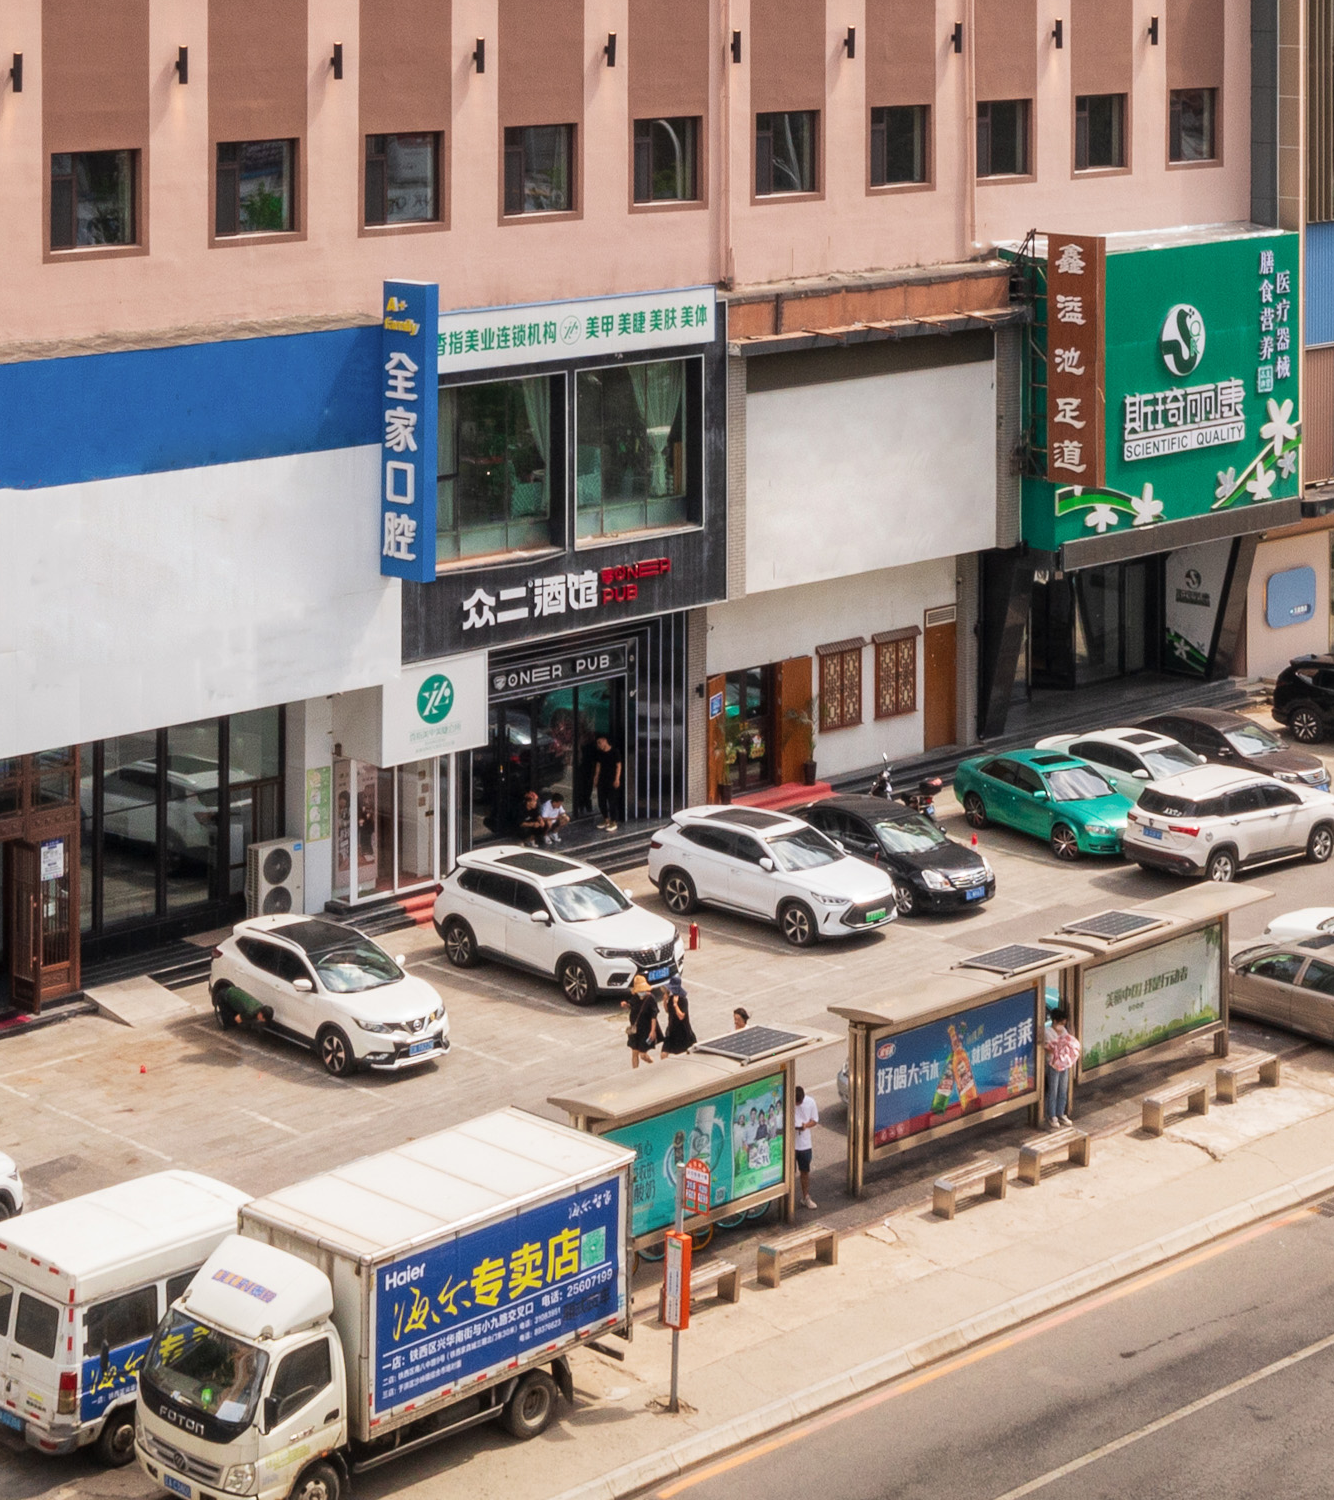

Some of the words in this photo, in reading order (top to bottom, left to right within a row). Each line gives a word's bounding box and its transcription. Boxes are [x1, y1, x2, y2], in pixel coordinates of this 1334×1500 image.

[586, 315, 614, 339] 美甲
[650, 307, 677, 332] 美肤
[681, 304, 708, 328] 美体
[1259, 250, 1275, 361] 膳食营养
[1275, 269, 1291, 379] 医疗器械
[383, 352, 418, 561] 全家口腔
[1126, 435, 1189, 460] SCIENTIFIC
[1196, 425, 1244, 446] QUALITY
[463, 569, 599, 631] 众二酒馆
[602, 584, 638, 605] PUB
[575, 654, 610, 673] PUB
[971, 1017, 1034, 1066] 就喝宏宝莱
[877, 1059, 940, 1096] 好喝大汽水
[385, 1262, 426, 1291] Haier
[393, 1227, 582, 1341] 海尔专卖店
[159, 1405, 205, 1436] FOTON
